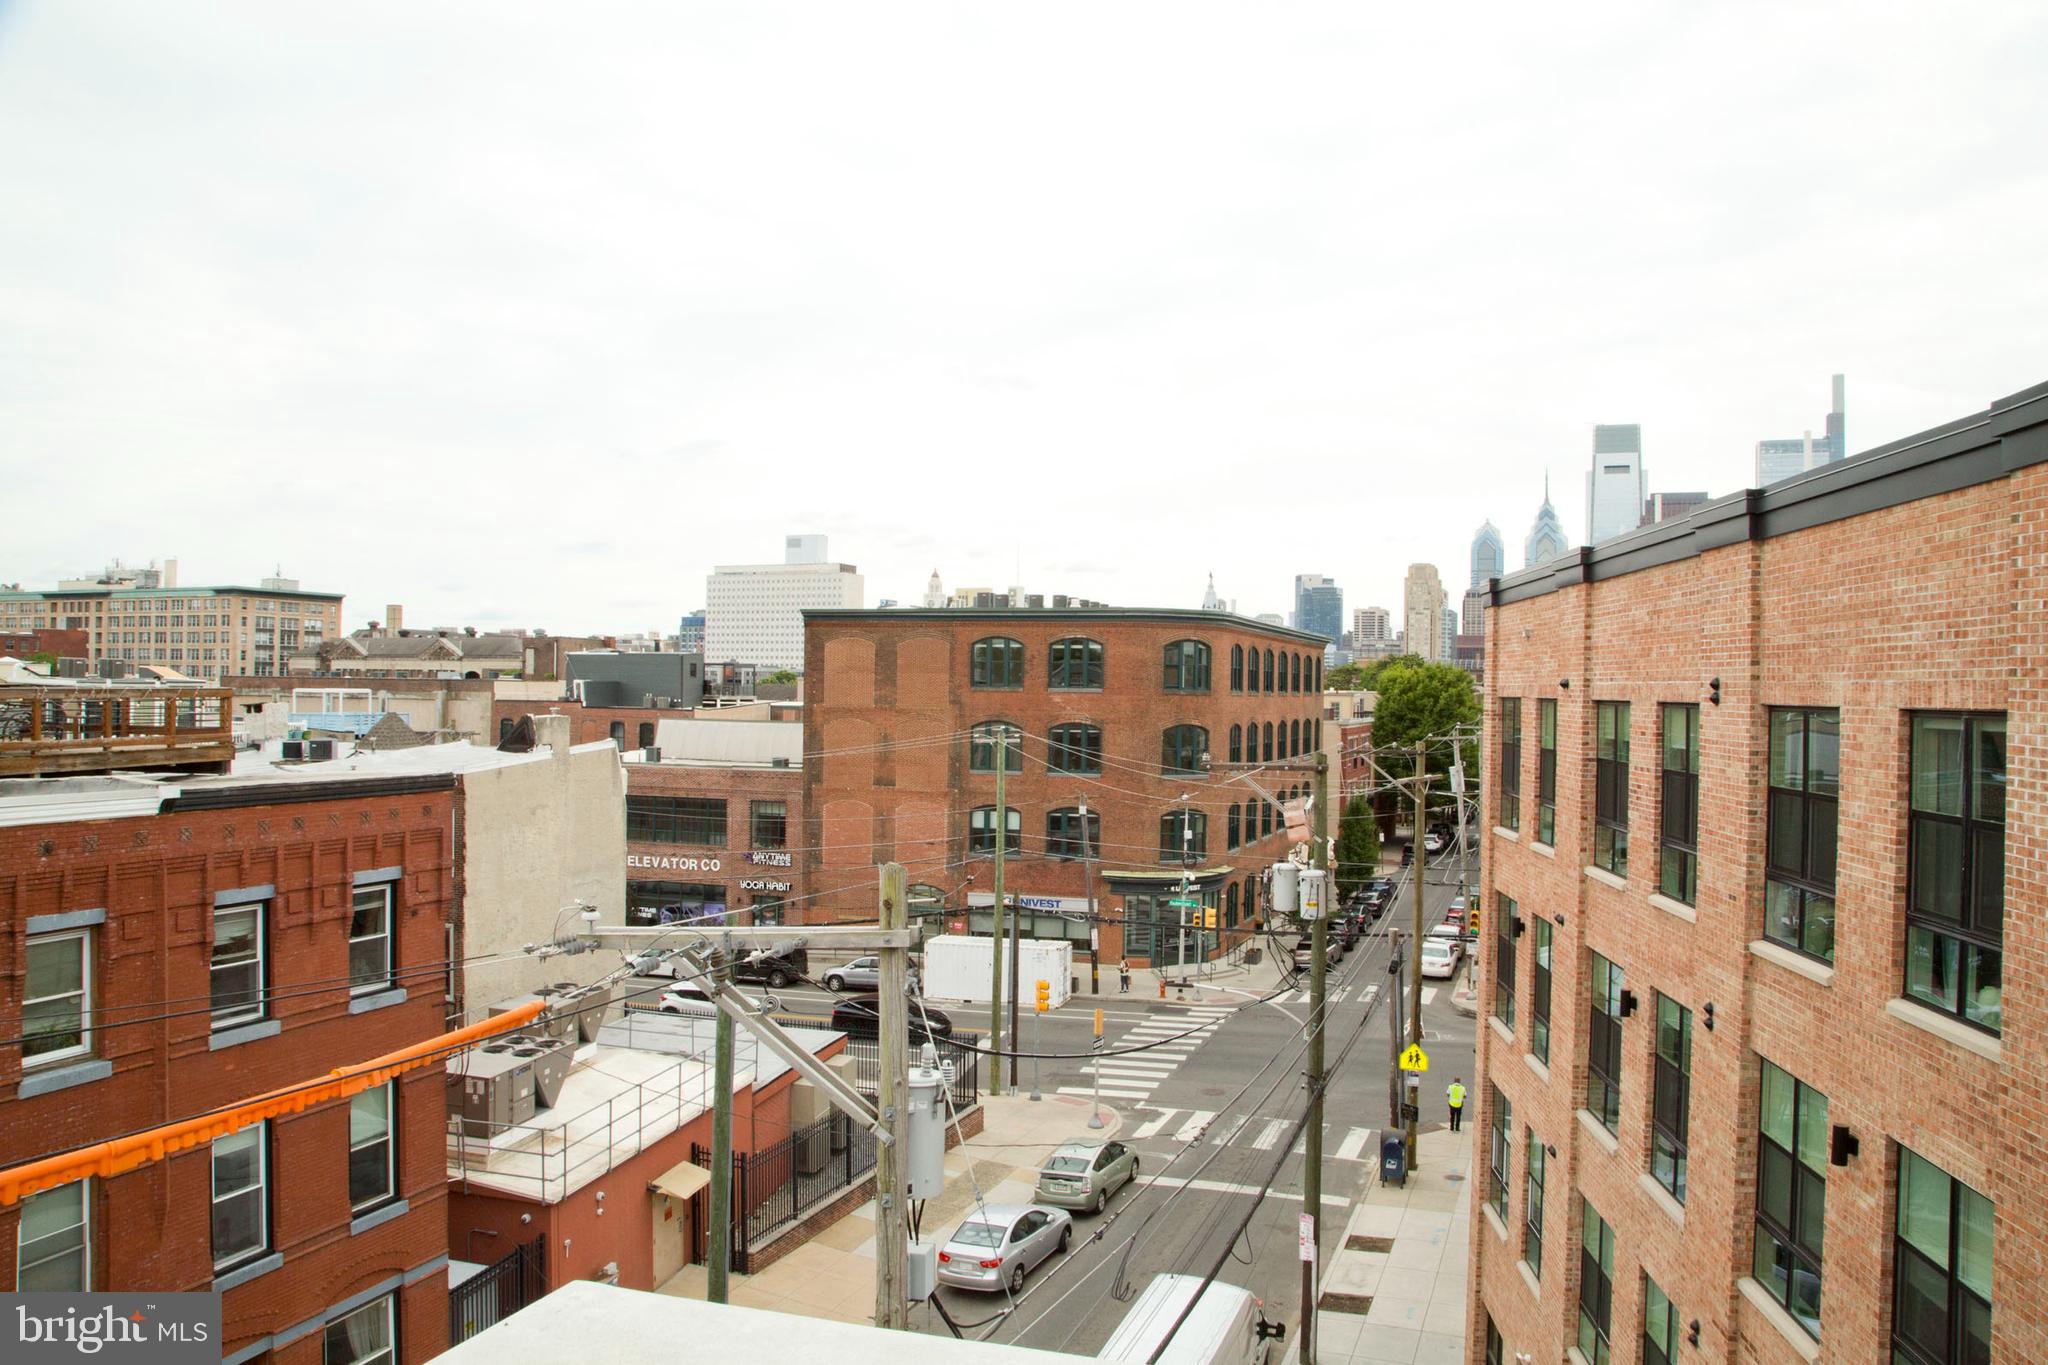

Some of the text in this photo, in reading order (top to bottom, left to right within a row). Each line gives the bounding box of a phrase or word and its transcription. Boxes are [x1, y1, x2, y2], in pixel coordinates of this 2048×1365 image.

[752, 851, 792, 861] ANYTIME
[627, 855, 721, 872] ELEVATOR CO
[753, 859, 792, 867] FITNESS
[740, 880, 791, 891] YOGA HABIT
[1015, 898, 1062, 909] NIVEST
